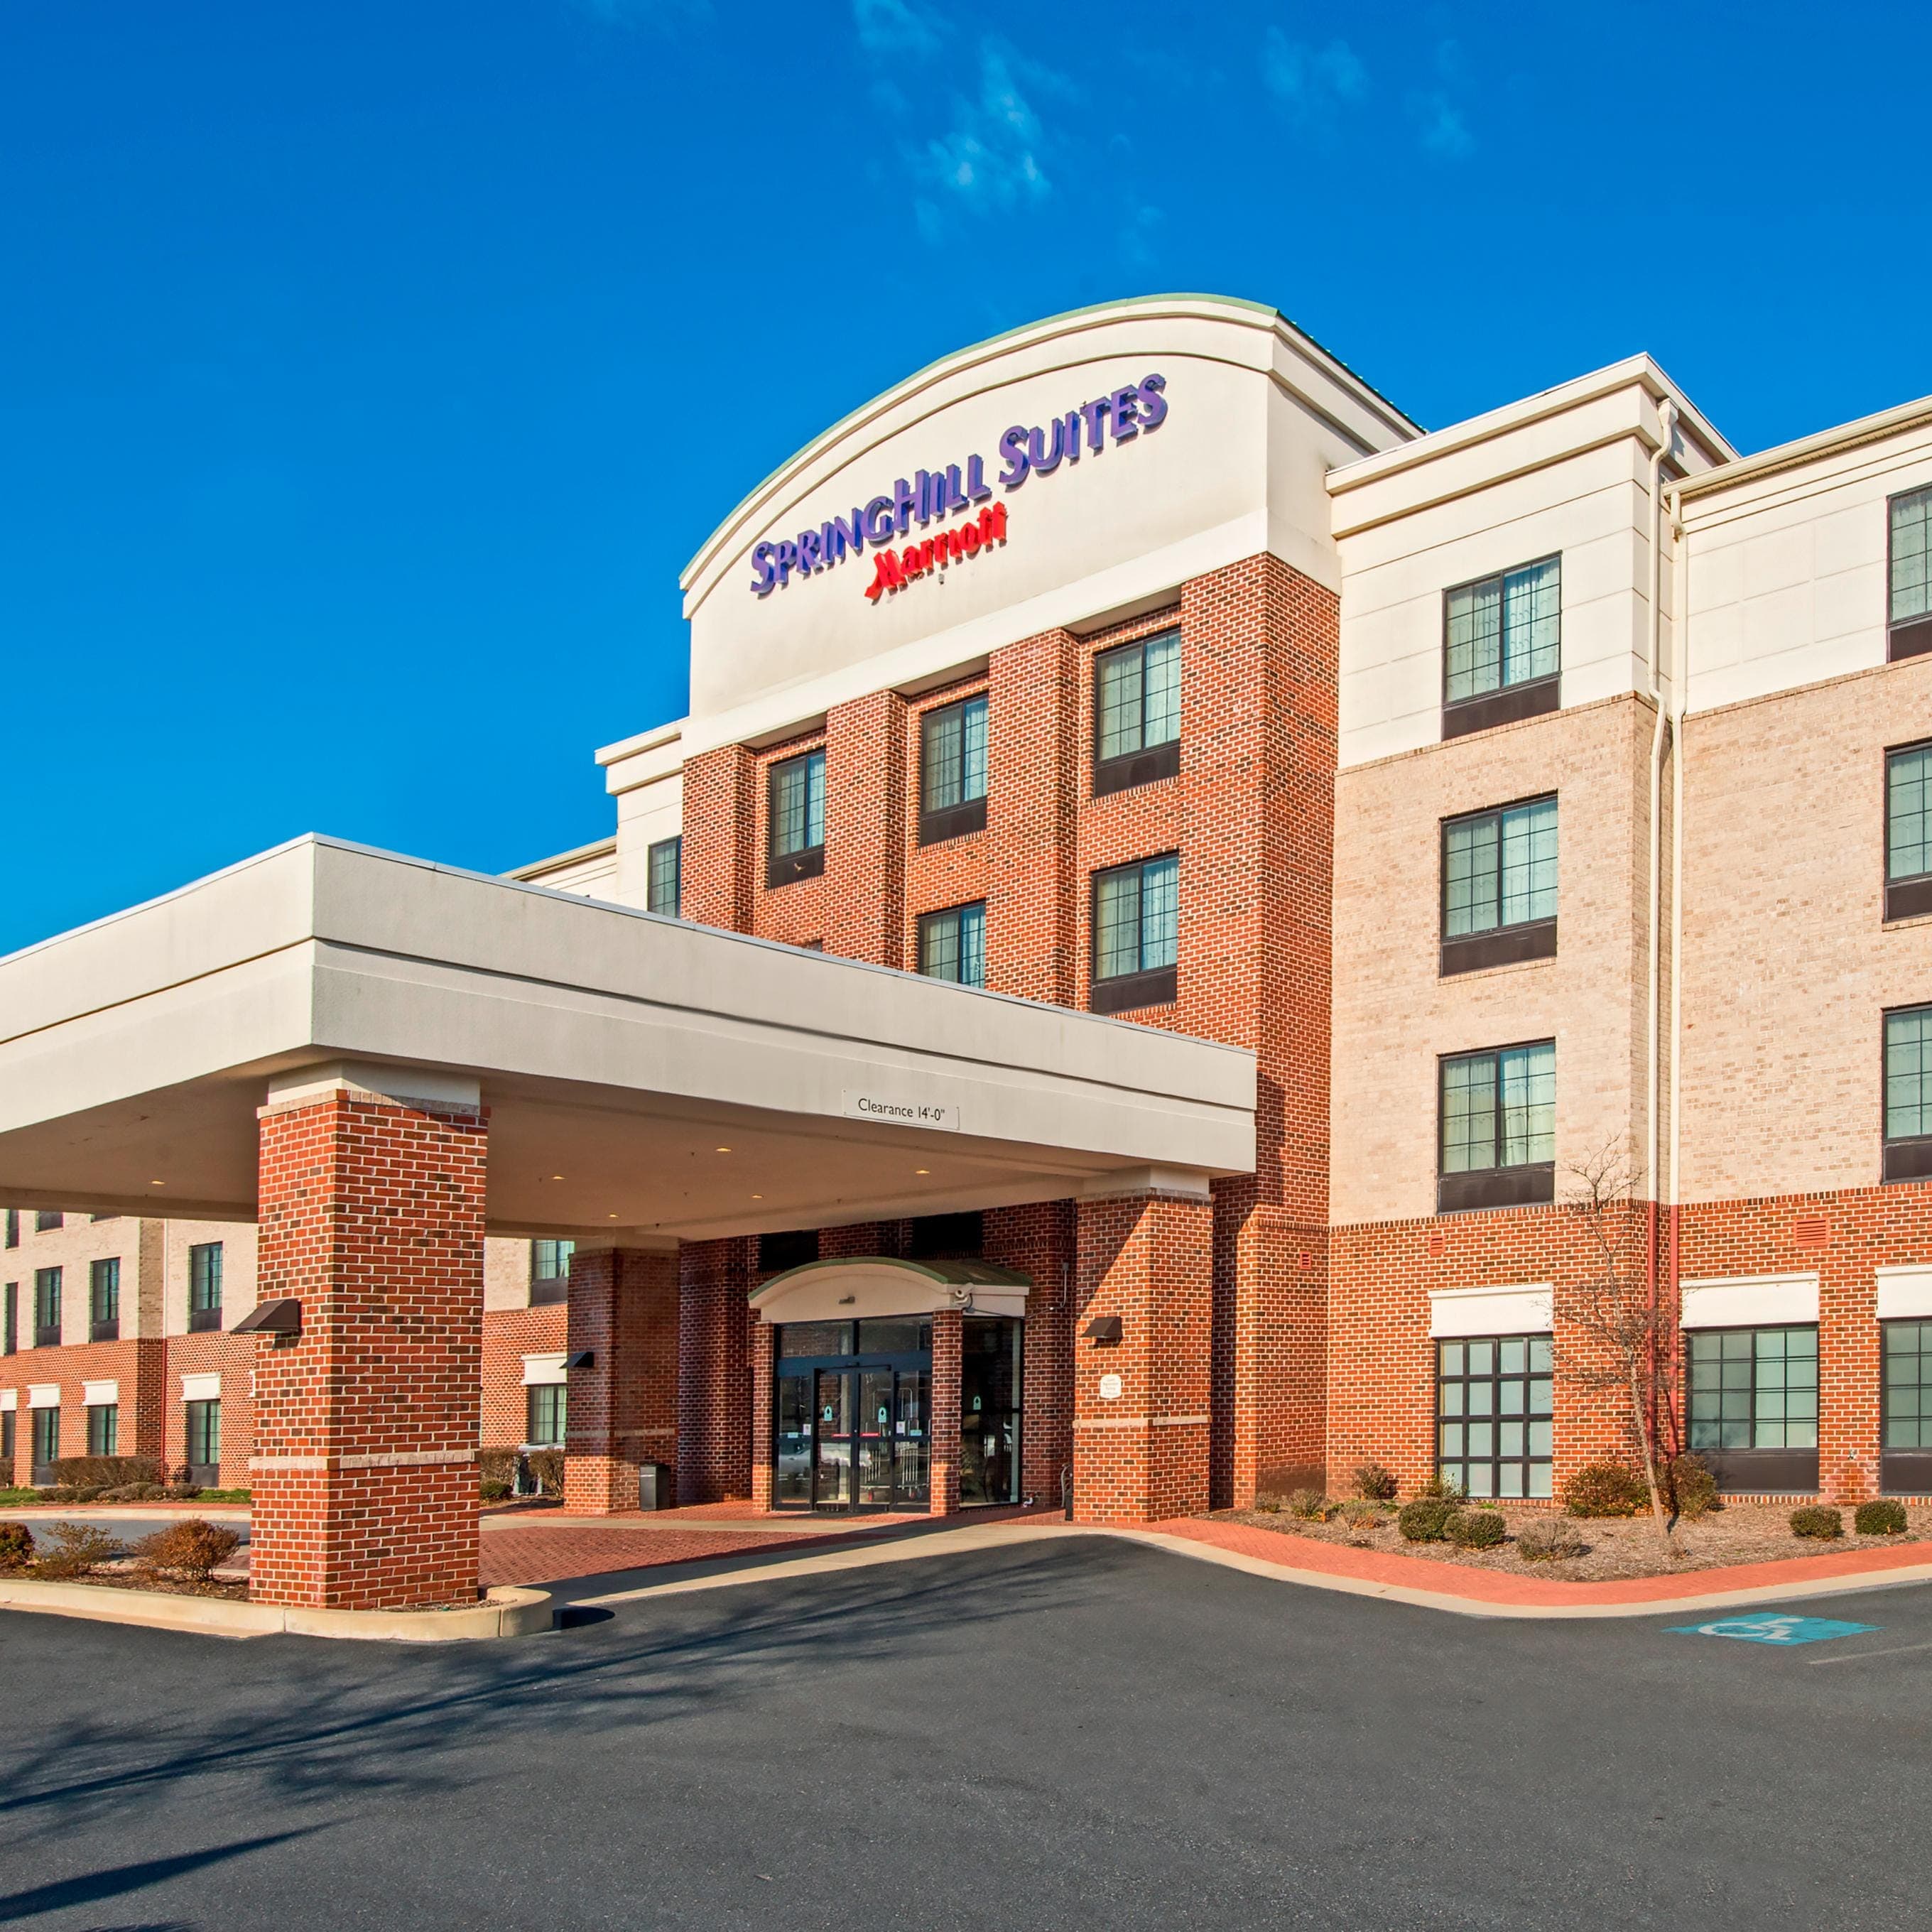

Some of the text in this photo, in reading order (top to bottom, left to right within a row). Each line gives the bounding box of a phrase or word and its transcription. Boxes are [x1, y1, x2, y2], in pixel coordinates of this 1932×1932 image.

[750, 373, 1168, 595] SPRINGHILL SUITES
[865, 500, 1007, 602] Marriott
[858, 1098, 945, 1121] Clearance 14'-0"
